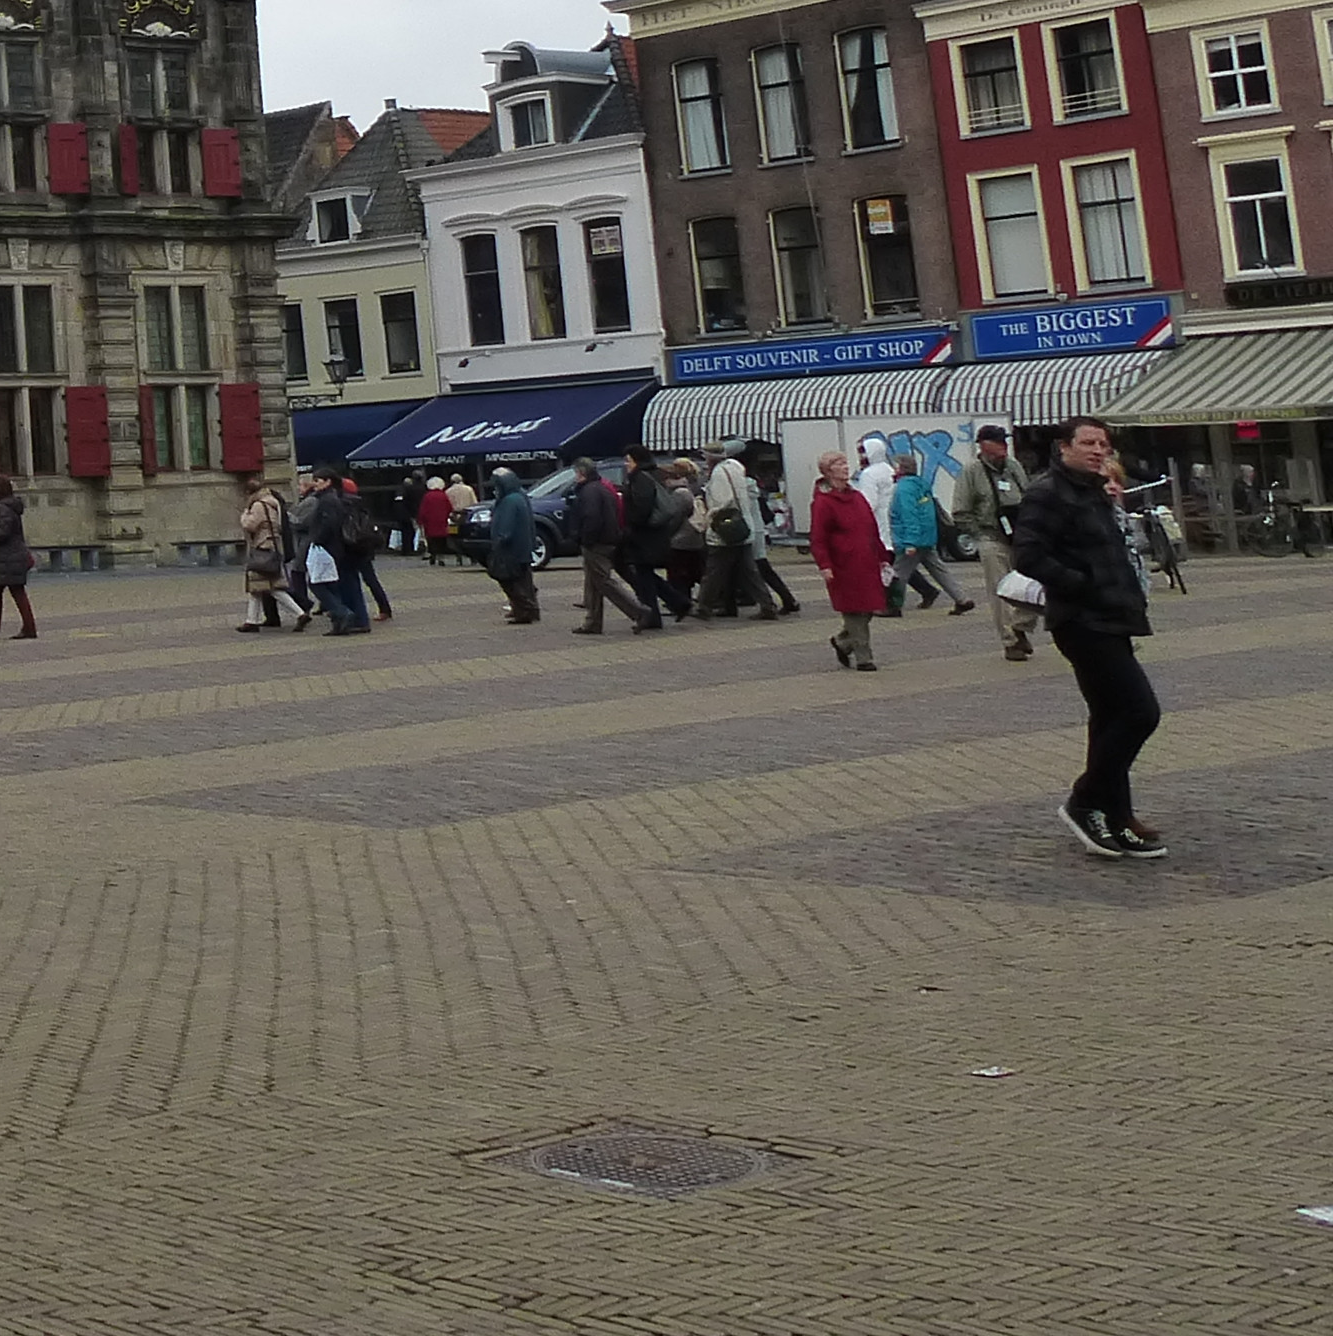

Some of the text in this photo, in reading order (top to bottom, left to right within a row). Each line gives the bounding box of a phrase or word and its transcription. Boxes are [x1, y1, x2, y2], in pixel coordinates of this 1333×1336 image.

[999, 307, 1136, 336] THE BIGGEST
[1037, 332, 1102, 348] IN TOWN
[683, 356, 732, 373] DELFT
[736, 349, 820, 369] SOUVENIR
[834, 344, 874, 361] GIFT
[878, 340, 925, 357] SHOP
[404, 455, 465, 466] RESTAURANT
